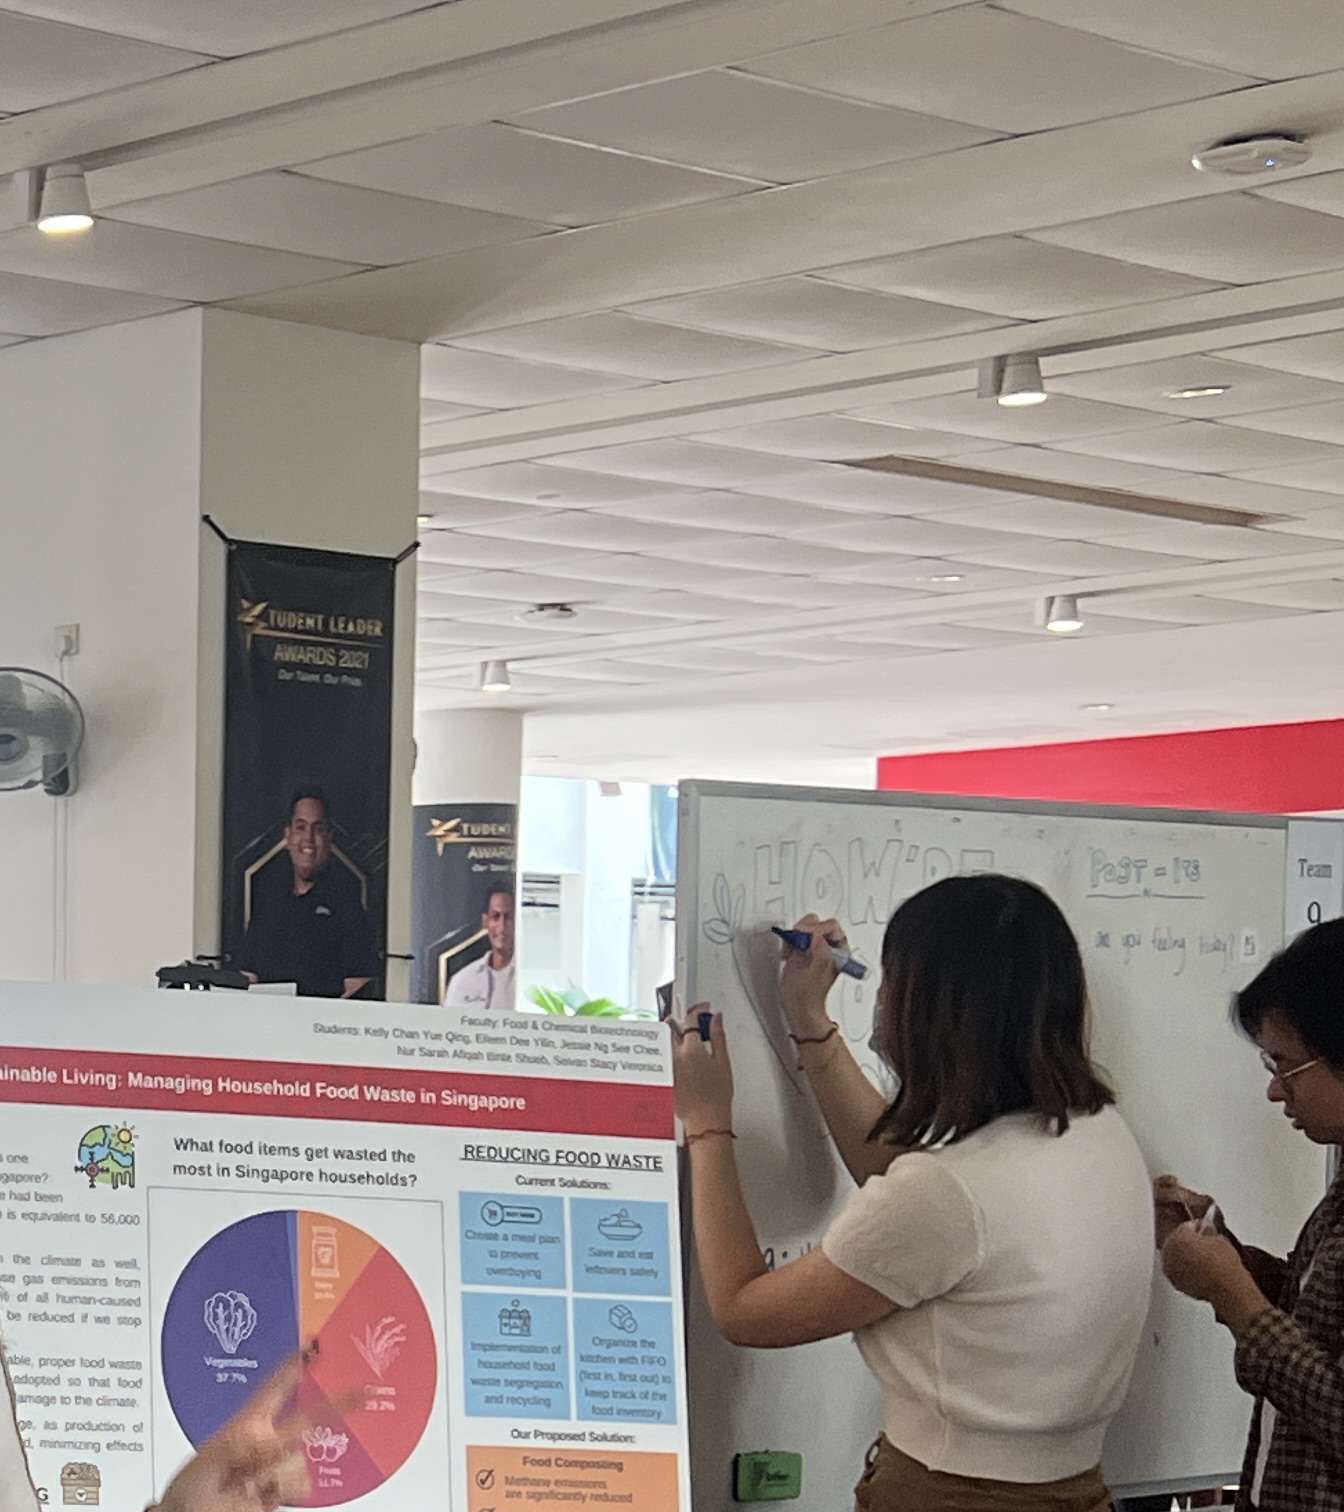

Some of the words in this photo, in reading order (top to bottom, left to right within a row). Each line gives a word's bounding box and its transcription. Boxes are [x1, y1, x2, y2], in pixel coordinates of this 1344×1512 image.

[330, 615, 383, 637] LEADER
[274, 644, 336, 666] AWARDS
[339, 651, 369, 668] 2021
[1298, 858, 1332, 878] Team
[62, 1068, 123, 1090] Living:
[127, 1071, 213, 1096] Managing
[217, 1077, 311, 1097] Household
[315, 1082, 359, 1100] Food
[364, 1085, 416, 1104] Waste
[420, 1088, 436, 1104] in
[441, 1090, 526, 1112] Singapore
[173, 1137, 213, 1153] What
[219, 1139, 253, 1155] food
[259, 1142, 300, 1158] items
[305, 1145, 328, 1161] get
[333, 1148, 386, 1162] wasted
[391, 1149, 415, 1163] the
[464, 1144, 550, 1162] REDUCING
[555, 1150, 601, 1167] FOOD
[605, 1152, 663, 1170] WASTE
[173, 1162, 212, 1177] most
[216, 1163, 230, 1178] in
[235, 1164, 314, 1183] Singapore
[319, 1169, 417, 1188] households?
[515, 1175, 556, 1188] Current
[558, 1177, 611, 1190] Solutions:
[9, 1191, 31, 1202] had
[35, 1191, 63, 1203] been
[7, 1208, 16, 1219] is
[22, 1210, 80, 1224] equivalent
[85, 1213, 96, 1224] to
[13, 1254, 31, 1265] the
[40, 1255, 81, 1267] climate
[92, 1258, 105, 1267] as
[115, 1258, 140, 1270] well,
[17, 1292, 28, 1302] of
[36, 1292, 49, 1303] all
[56, 1294, 141, 1307] human-caused
[7, 1311, 21, 1321] be
[28, 1312, 75, 1323] reduced
[82, 1313, 88, 1323] if
[94, 1315, 110, 1324] we
[117, 1316, 141, 1328] stop
[39, 1358, 75, 1370] proper
[80, 1358, 105, 1369] food
[109, 1360, 142, 1370] waste
[14, 1375, 60, 1387] adopted
[68, 1378, 81, 1387] so
[88, 1377, 110, 1388] that
[118, 1378, 142, 1389] food
[18, 1394, 56, 1406] amage
[61, 1395, 71, 1405] to
[75, 1395, 93, 1406] the
[96, 1396, 139, 1408] climate.
[43, 1421, 57, 1430] as
[65, 1421, 125, 1433] production
[133, 1422, 143, 1433] of
[511, 1428, 531, 1439] Our
[534, 1429, 585, 1444] Proposed
[589, 1431, 635, 1444] Solution:
[39, 1439, 101, 1453] minimizing
[106, 1440, 144, 1452] effects
[523, 1456, 551, 1467] Food
[555, 1457, 623, 1472] Composting
[504, 1475, 550, 1488] Methane
[554, 1478, 607, 1489] emissions
[505, 1490, 522, 1498] are
[526, 1490, 587, 1504] significantly
[590, 1492, 632, 1503] reduced
